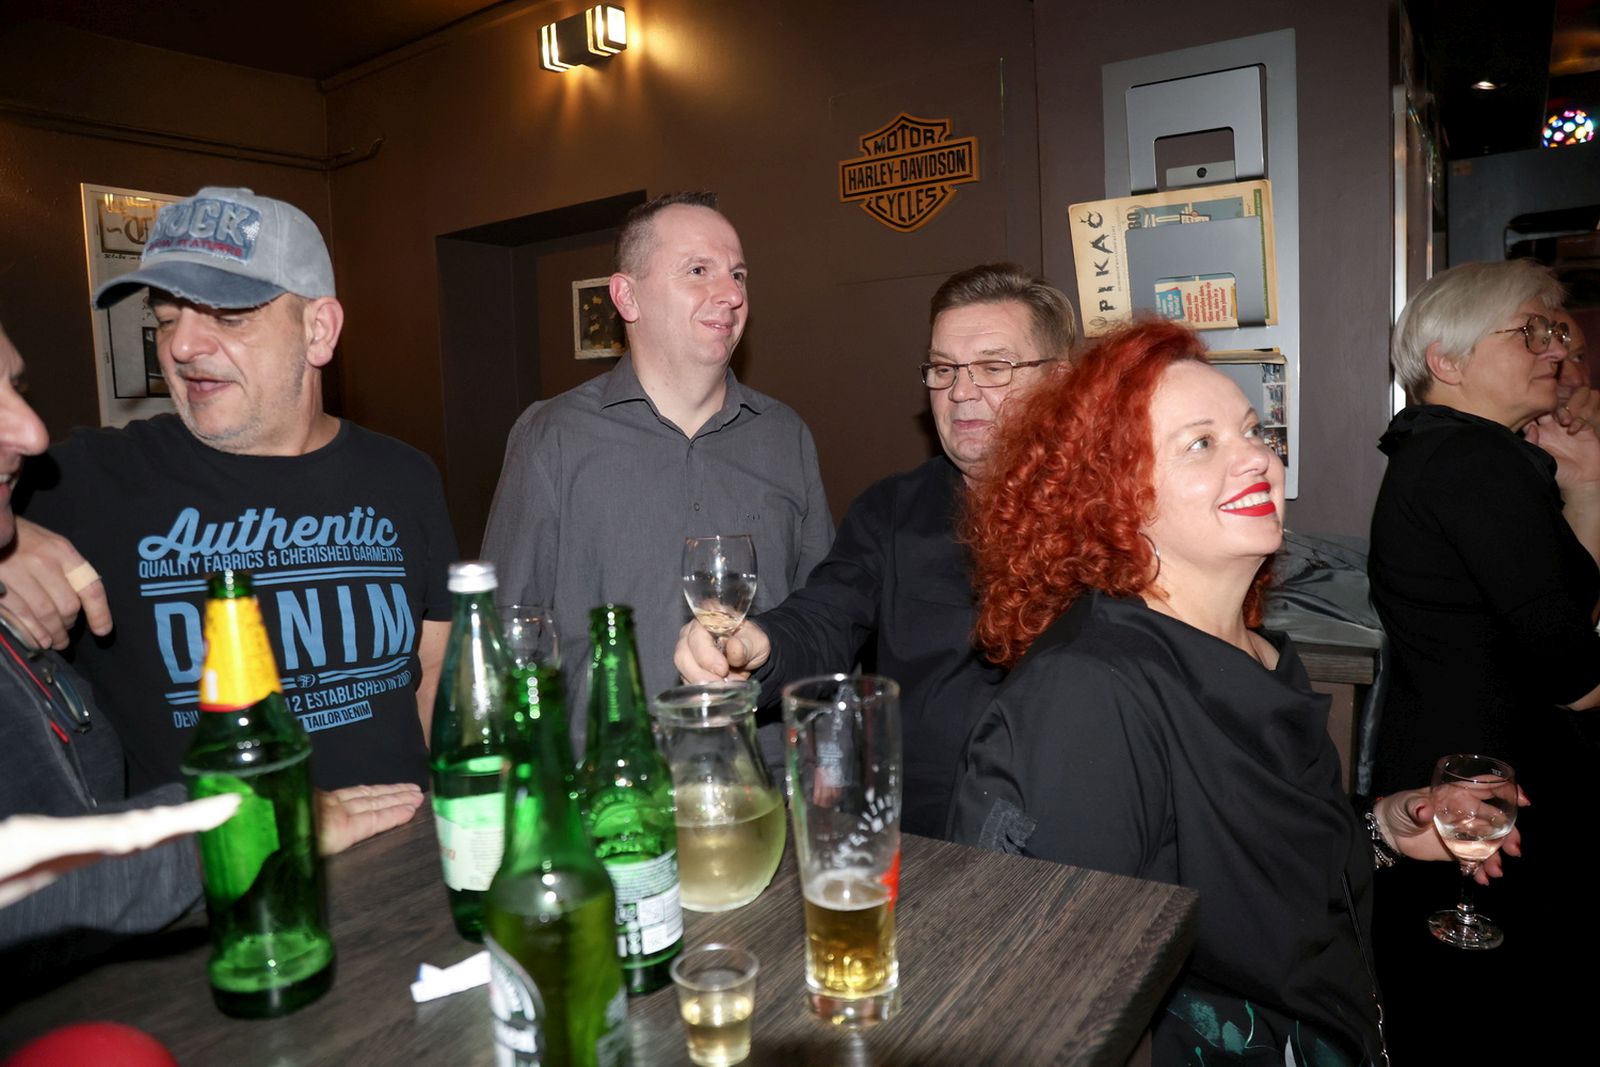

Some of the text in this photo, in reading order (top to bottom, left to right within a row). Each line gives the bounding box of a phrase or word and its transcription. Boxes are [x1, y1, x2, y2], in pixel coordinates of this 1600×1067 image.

[873, 123, 936, 155] MOTOR
[848, 148, 967, 191] HARLEY-DAVIDSON
[874, 186, 937, 223] CYCLES
[138, 506, 399, 565] Authentic
[139, 546, 404, 579] QUALITY FABRICS & CHERISHED GARMENTS
[154, 583, 416, 684] DNIM
[305, 681, 387, 710] ESTABLISHED
[305, 711, 342, 729] TAILOR
[342, 703, 371, 721] DENIM
